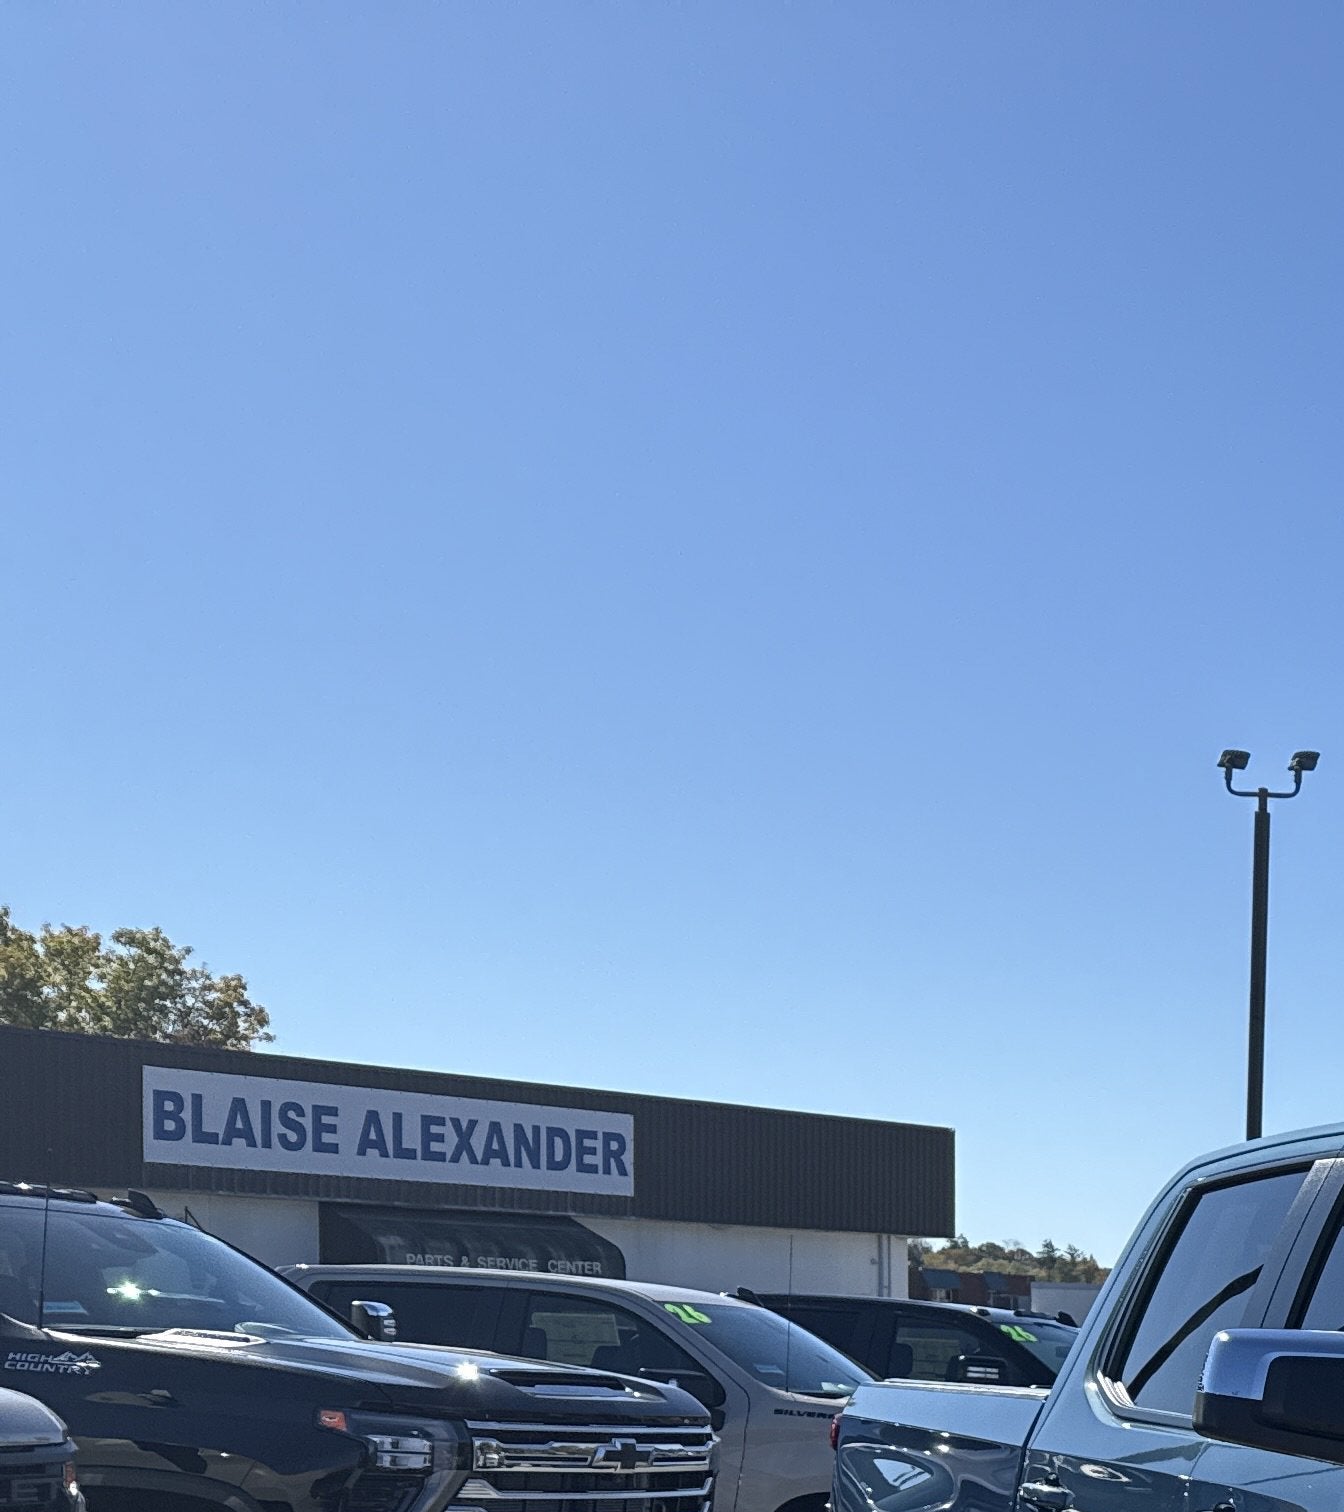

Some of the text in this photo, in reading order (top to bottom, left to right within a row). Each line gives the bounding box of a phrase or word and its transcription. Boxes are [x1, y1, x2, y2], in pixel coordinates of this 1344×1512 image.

[152, 1089, 629, 1177] BLAISE ALEXANDER
[406, 1253, 601, 1274] PARTS & SERVICE CENTER
[664, 1303, 712, 1324] 26
[7, 1352, 53, 1362] HIGH
[4, 1361, 92, 1375] COUNTRY
